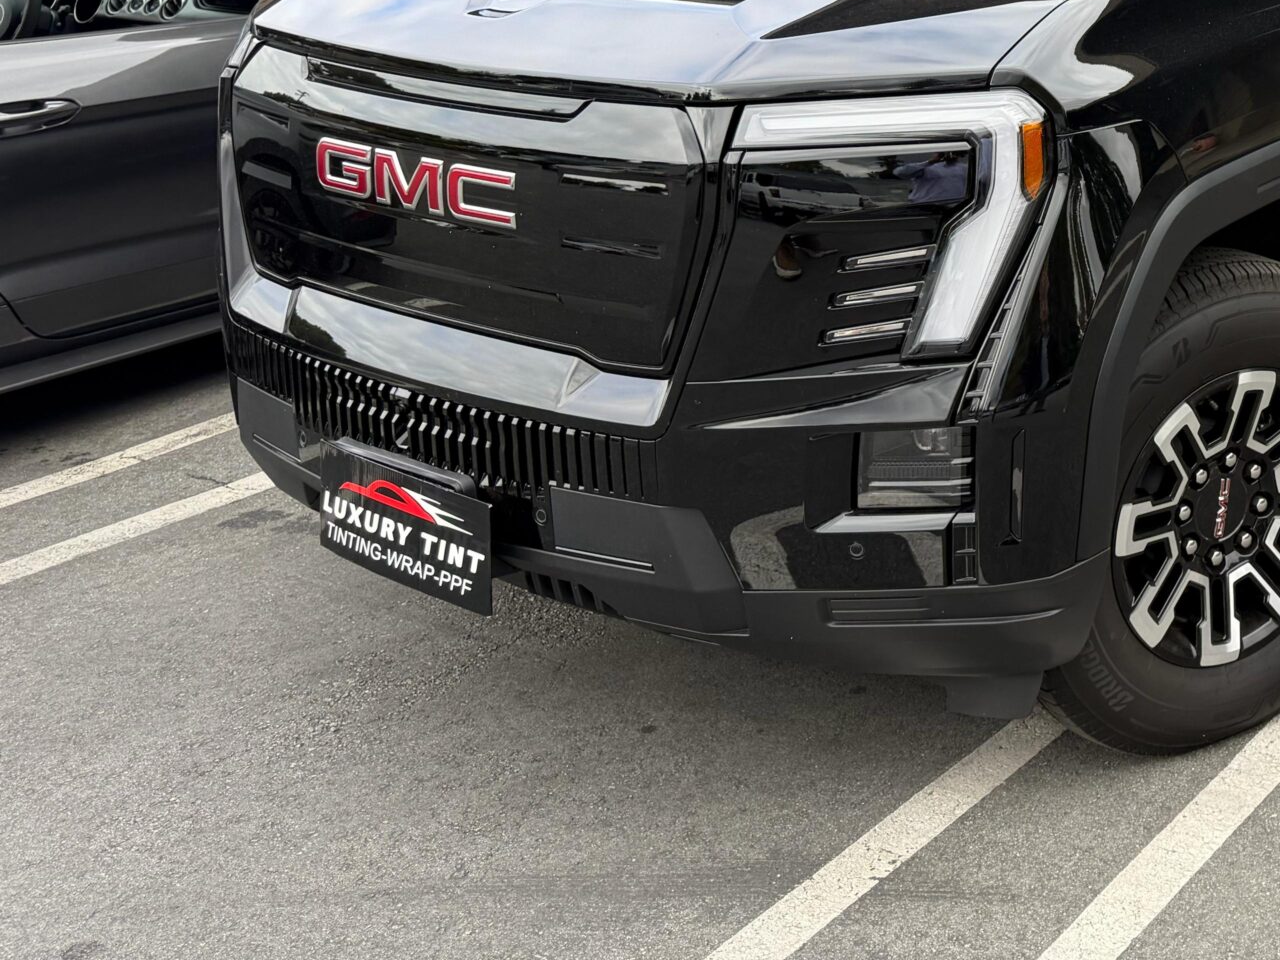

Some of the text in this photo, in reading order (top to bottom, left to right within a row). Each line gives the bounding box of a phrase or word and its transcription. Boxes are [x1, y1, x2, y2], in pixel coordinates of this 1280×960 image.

[316, 136, 517, 230] GMC
[322, 490, 486, 575] LUXURY TINT
[1213, 477, 1232, 539] GMC
[326, 520, 474, 597] TINTING-WRAP-PPF
